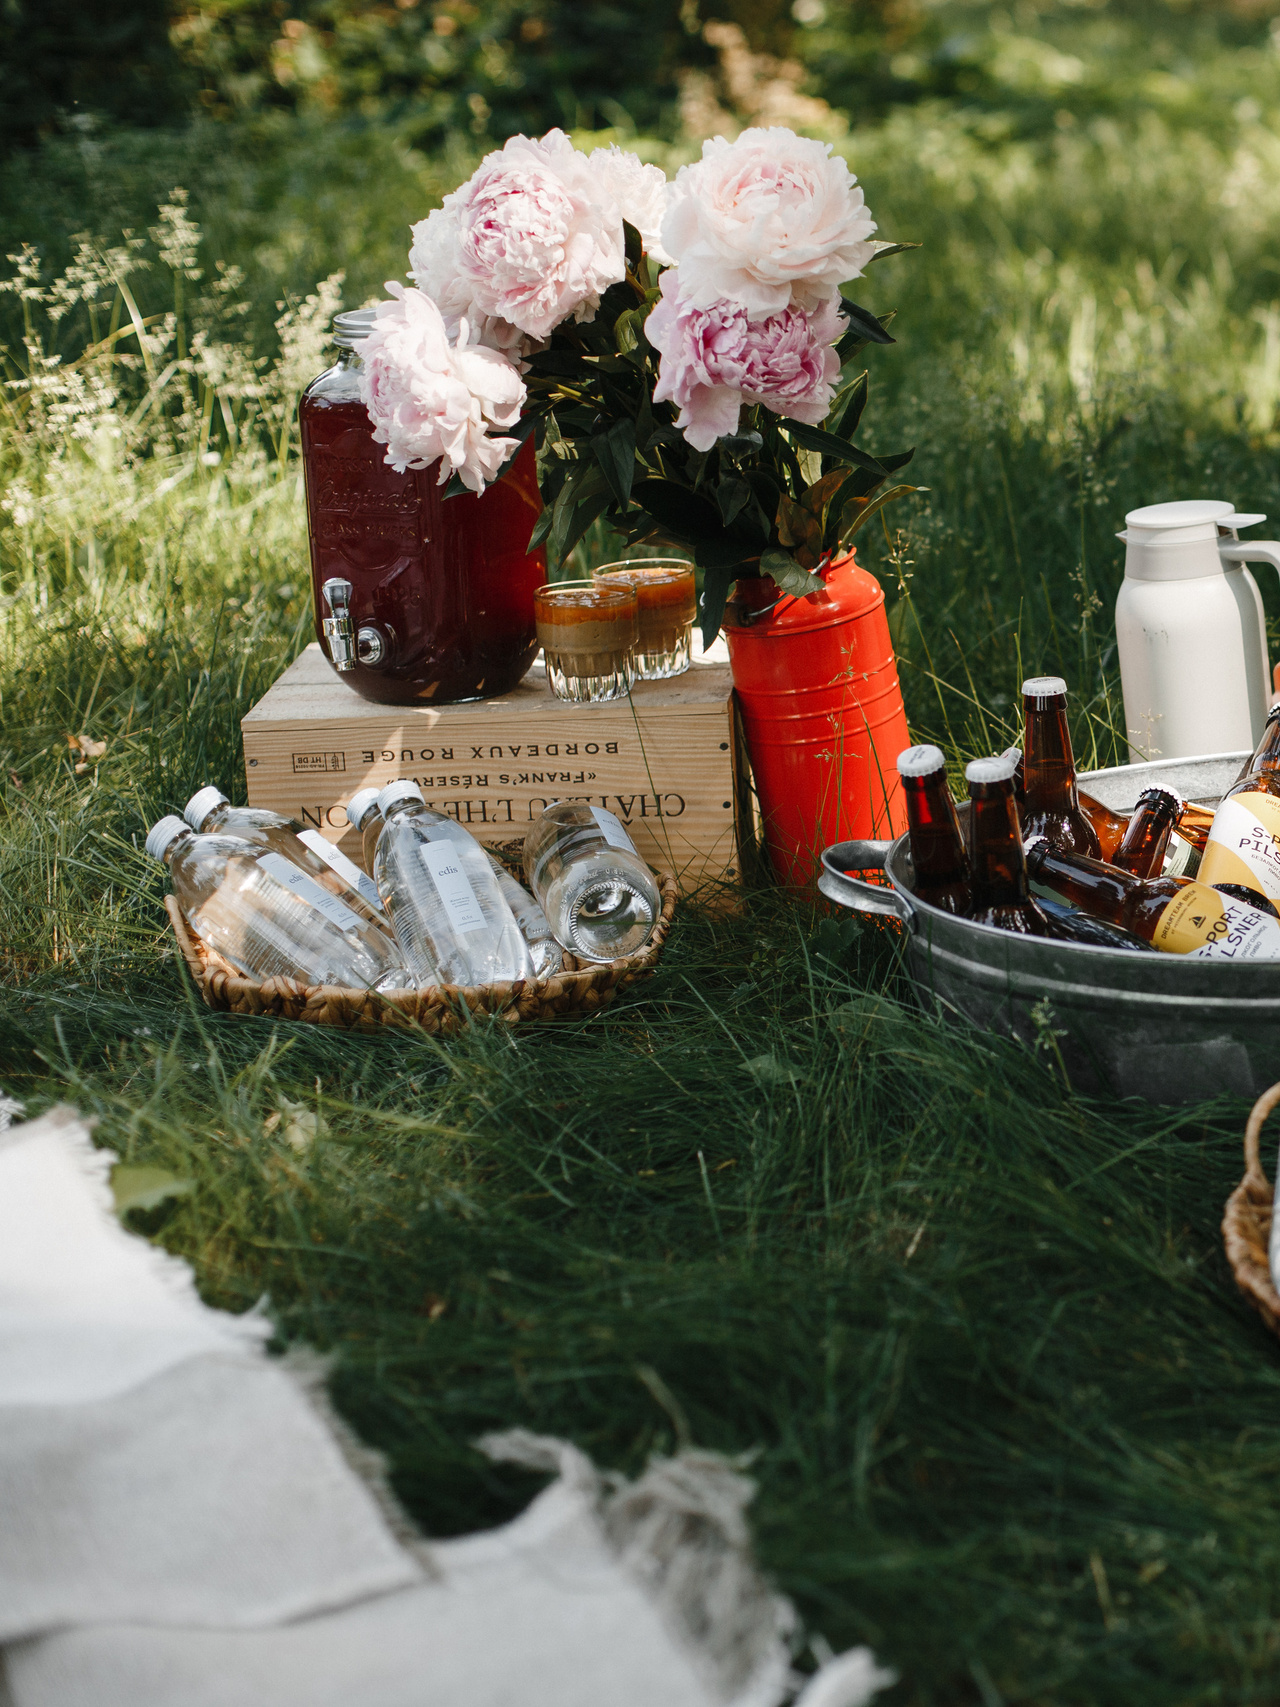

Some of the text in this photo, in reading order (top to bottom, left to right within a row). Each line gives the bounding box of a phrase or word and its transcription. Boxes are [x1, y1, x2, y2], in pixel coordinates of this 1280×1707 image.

[362, 741, 619, 763] BORDEAUX ROUGE
[438, 865, 459, 877] edis
[1160, 902, 1183, 940] DREAMTEAM
[1220, 912, 1267, 958] LSNER
